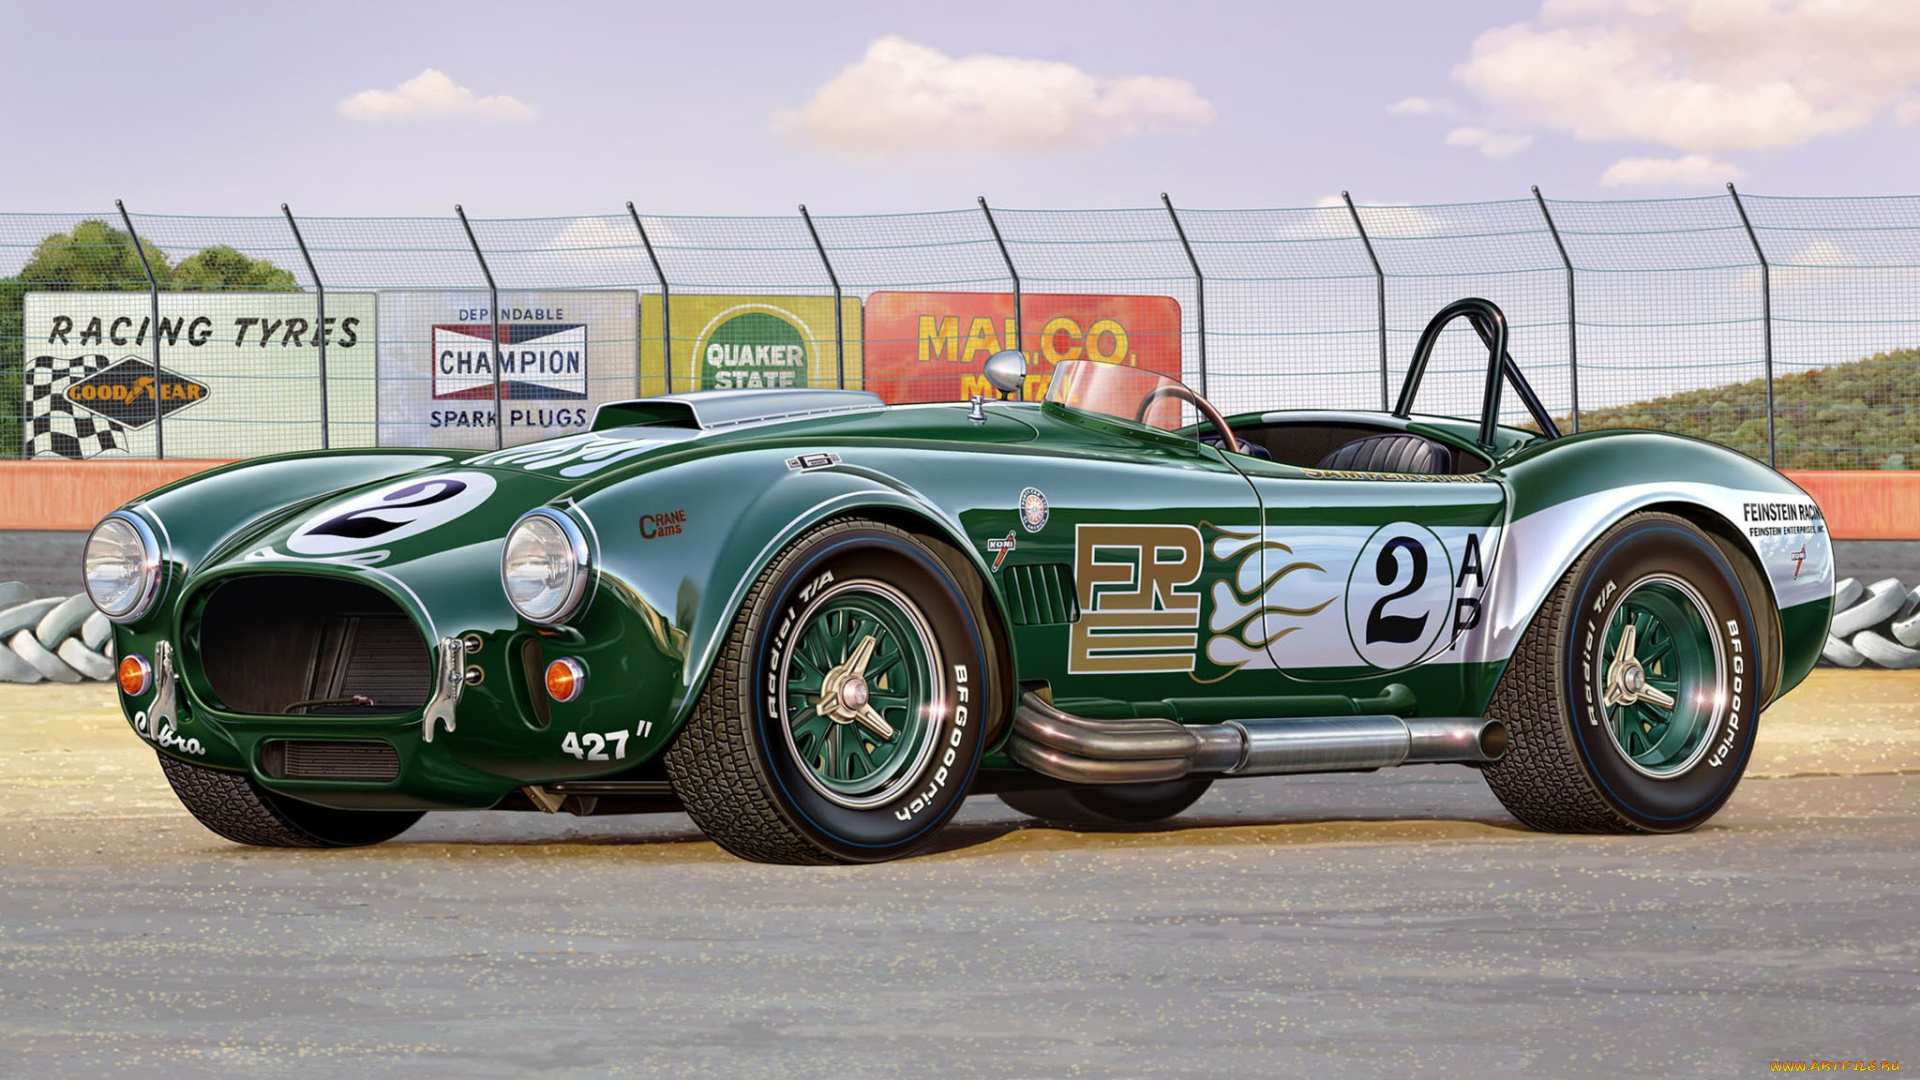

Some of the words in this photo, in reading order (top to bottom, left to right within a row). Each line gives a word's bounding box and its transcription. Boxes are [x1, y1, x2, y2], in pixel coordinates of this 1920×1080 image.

[459, 308, 563, 321] DEPNDABLE
[48, 315, 213, 346] RACING
[234, 317, 360, 348] TYRES
[439, 349, 580, 375] CHAMPION
[706, 343, 804, 368] QUAKER
[68, 377, 201, 404] GOODYEAR
[714, 371, 796, 390] STATE
[430, 410, 499, 428] SPARK
[510, 408, 587, 428] PLUGS
[302, 479, 468, 539] 2
[1743, 503, 1798, 522] FEINSTEIN
[989, 540, 1014, 549] KONI
[798, 570, 835, 604] T/A
[1365, 535, 1431, 646] 2
[1593, 579, 1618, 614] T/A
[1708, 619, 1744, 768] BFGoodrich
[134, 710, 206, 756] Cbra
[894, 663, 969, 822] BFGoodrich
